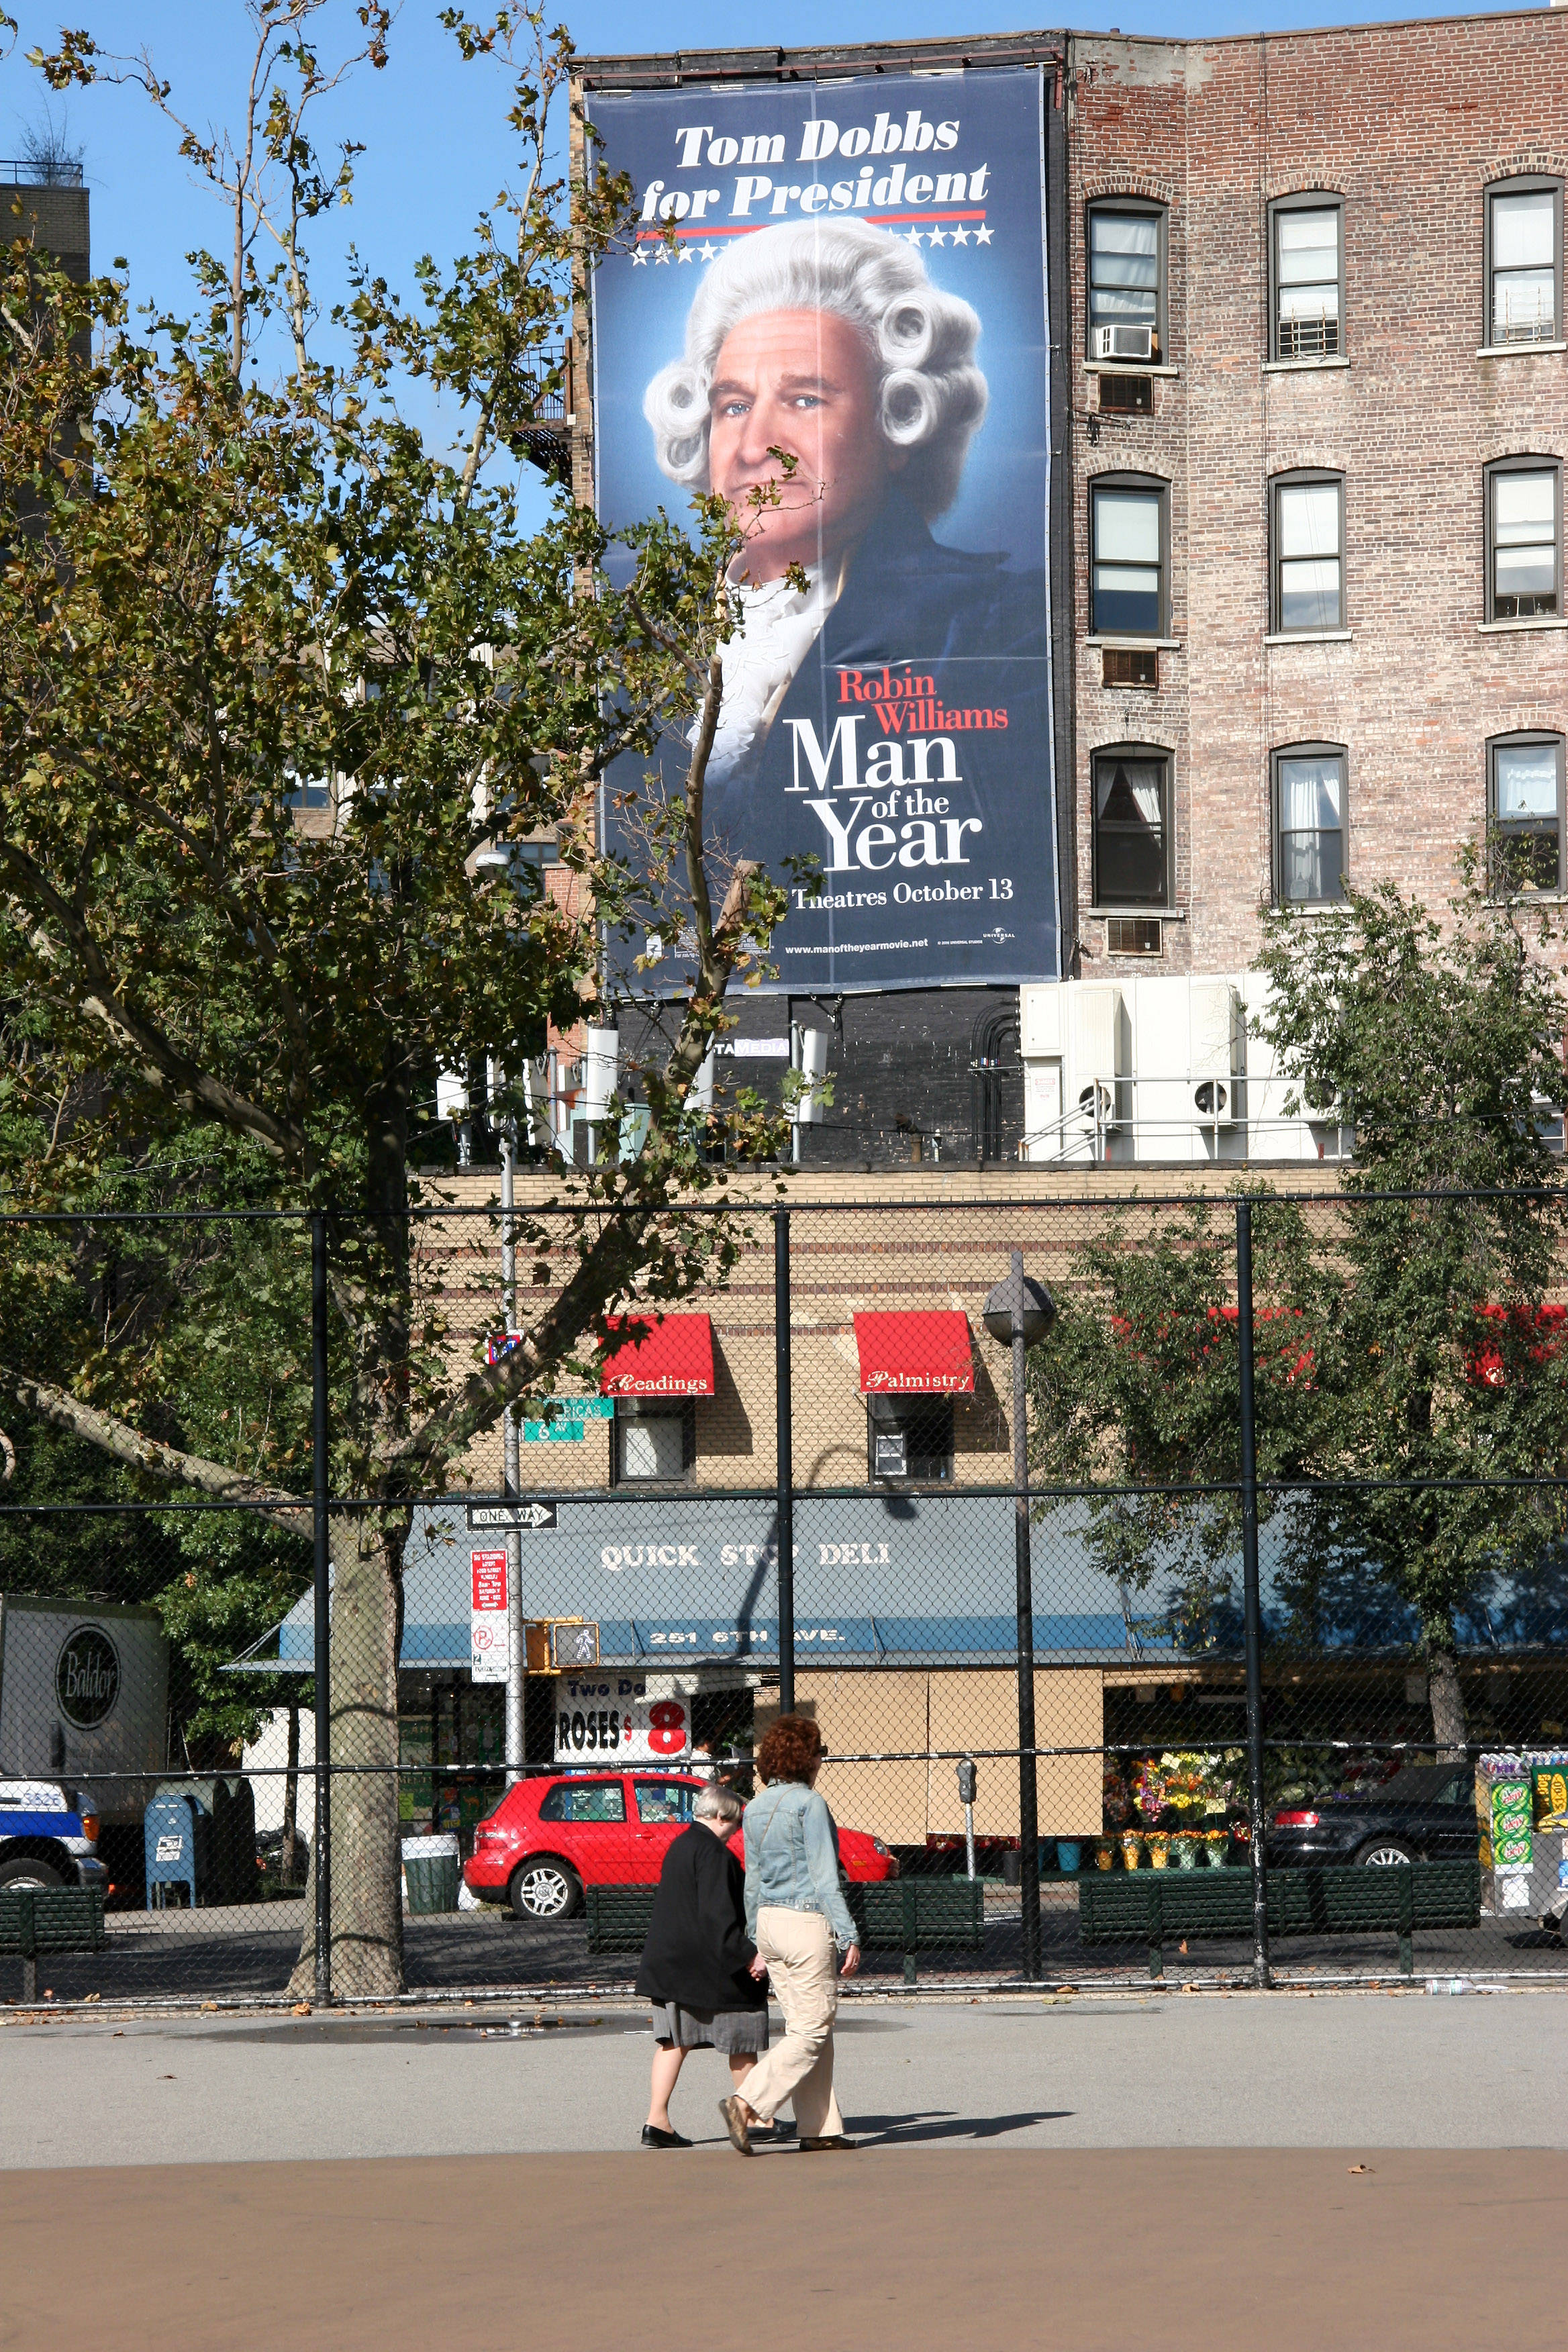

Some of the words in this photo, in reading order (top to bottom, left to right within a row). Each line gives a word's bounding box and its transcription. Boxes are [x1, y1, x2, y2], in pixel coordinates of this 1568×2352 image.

[675, 126, 786, 167] Tom
[795, 110, 960, 161] Dobbs
[638, 180, 720, 222] for
[728, 162, 991, 216] President
[836, 667, 937, 703] Robin
[871, 699, 1009, 736] Williams
[782, 714, 963, 792] Man
[871, 789, 901, 818] of
[904, 788, 950, 816] the
[802, 796, 983, 872] Year
[791, 888, 887, 910] Theatres
[893, 880, 983, 904] October
[988, 878, 1014, 900] 13
[785, 938, 929, 954] www.manoftheyearmovie.net
[714, 1042, 787, 1055] TAMEDIA
[607, 1373, 707, 1393] Readings
[866, 1371, 970, 1390] Palmistry
[538, 1423, 550, 1440] 6
[480, 1510, 505, 1522] ONE
[520, 1508, 544, 1522] WAY
[601, 1544, 702, 1571] QUICK
[818, 1543, 891, 1565] DELI
[650, 1632, 697, 1644] 251
[712, 1630, 768, 1643] 6TH
[65, 1651, 116, 1699] Baldor
[568, 1679, 610, 1697] Two
[558, 1710, 620, 1751] ROSES
